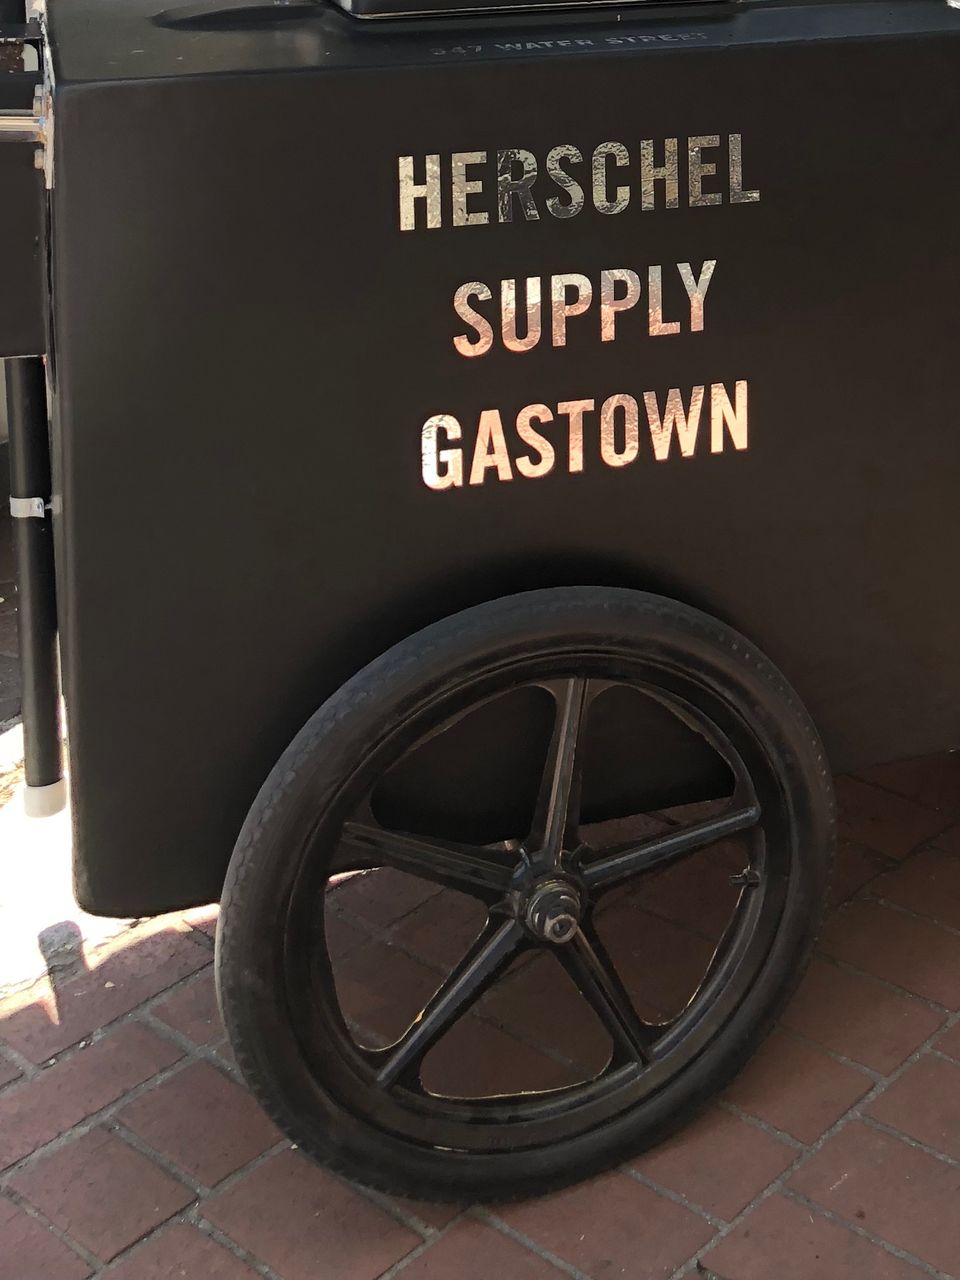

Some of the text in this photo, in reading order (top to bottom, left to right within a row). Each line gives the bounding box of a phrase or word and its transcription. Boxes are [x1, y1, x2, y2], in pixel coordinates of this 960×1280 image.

[398, 133, 761, 232] HERSCHEL
[452, 259, 717, 358] SUPPLY
[420, 380, 748, 492] GASTOWN
